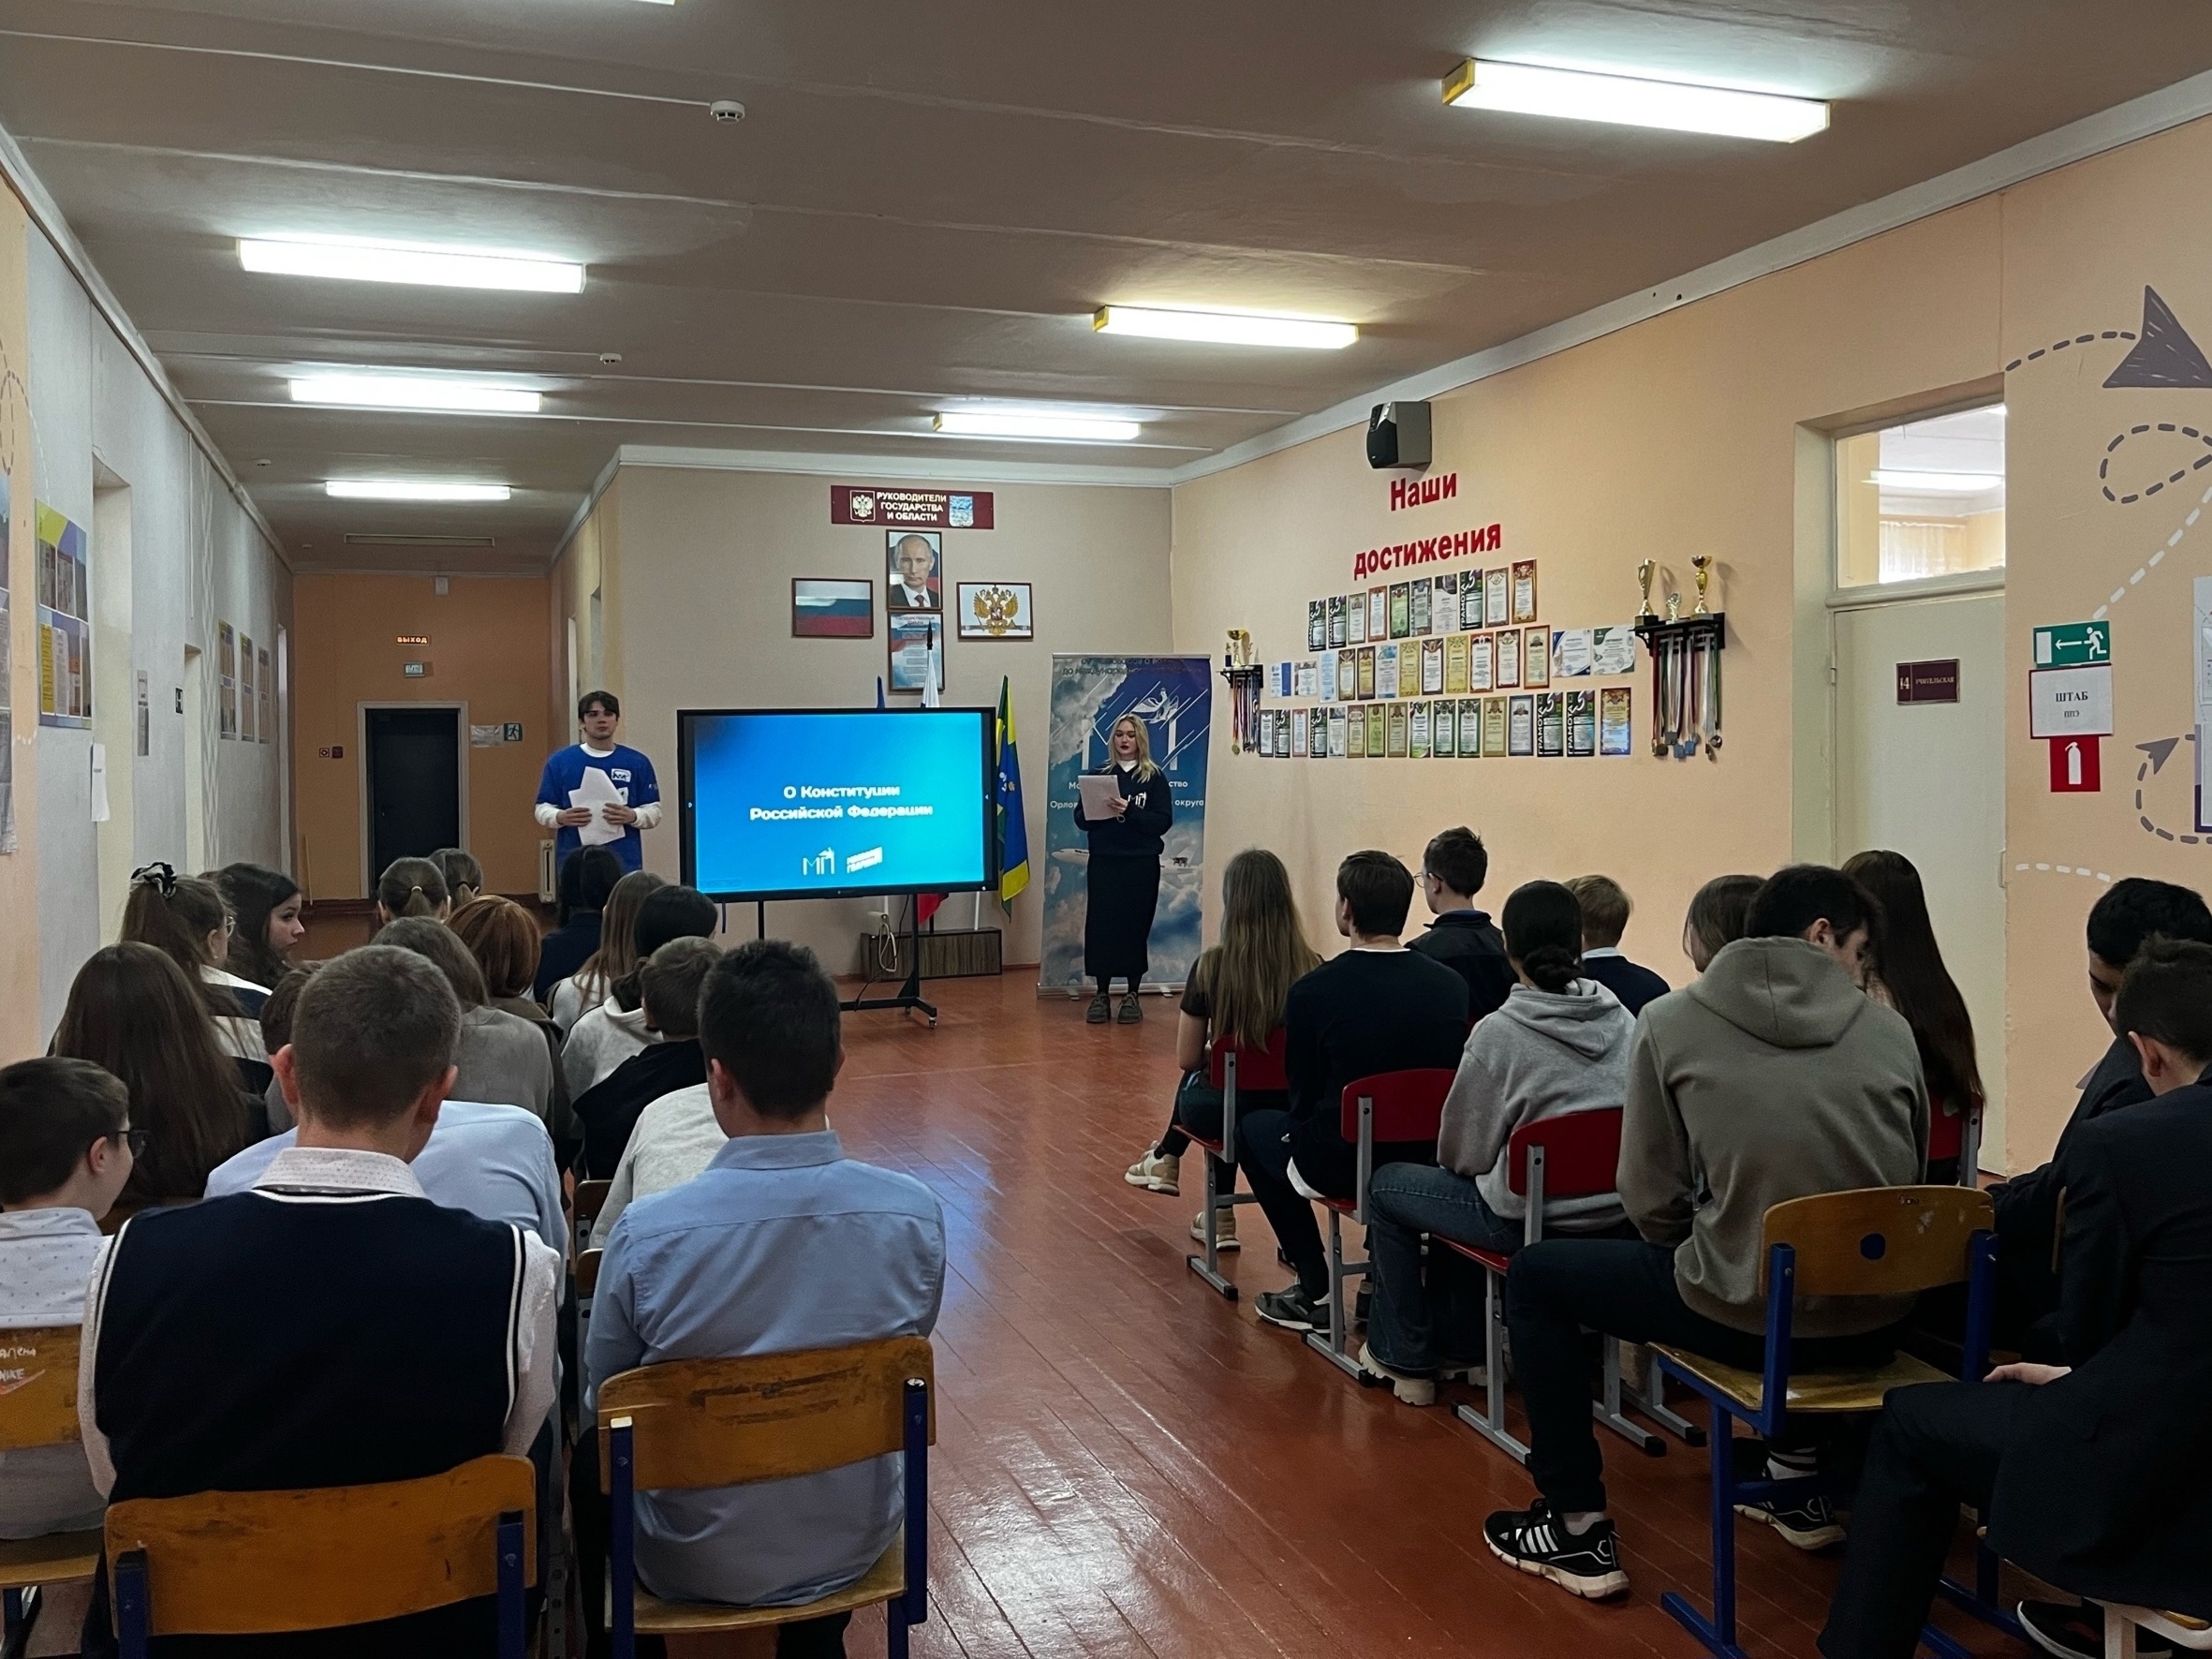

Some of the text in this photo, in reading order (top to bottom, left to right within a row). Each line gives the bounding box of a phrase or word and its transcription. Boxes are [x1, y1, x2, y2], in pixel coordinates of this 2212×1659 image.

[876, 491, 947, 503] РУКОВОДИТЕЛИ
[1391, 472, 1457, 511] Наши
[880, 501, 943, 512] ГОСУДАРСТВА
[887, 511, 937, 522] И ОБЛАСТИ
[1354, 523, 1501, 581] достижения
[397, 636, 428, 644] ВЫХОД
[1899, 676, 1910, 689] 14
[2056, 691, 2088, 702] ШТАБ
[783, 785, 901, 799] О Конституции
[1174, 799, 1204, 807] округа
[750, 804, 933, 821] Российской Федерации
